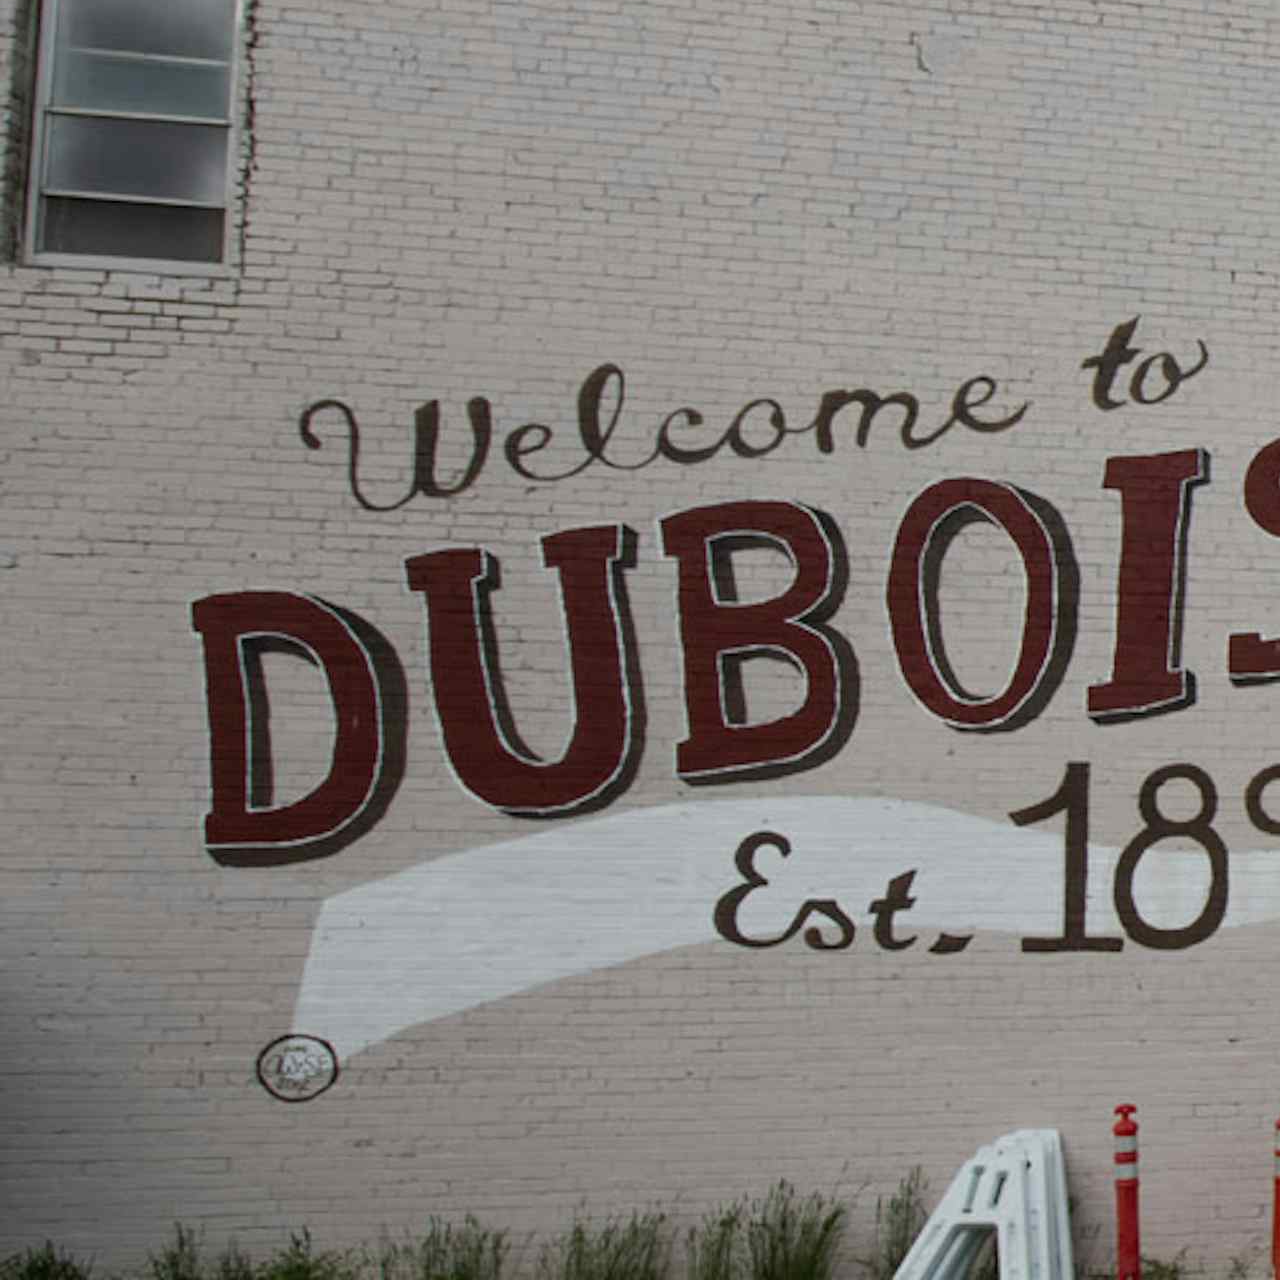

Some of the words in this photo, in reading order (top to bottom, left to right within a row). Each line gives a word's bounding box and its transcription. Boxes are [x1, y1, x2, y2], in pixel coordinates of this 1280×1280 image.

[299, 363, 1030, 511] Welcome
[1081, 314, 1208, 409] to
[713, 831, 974, 953] Est.
